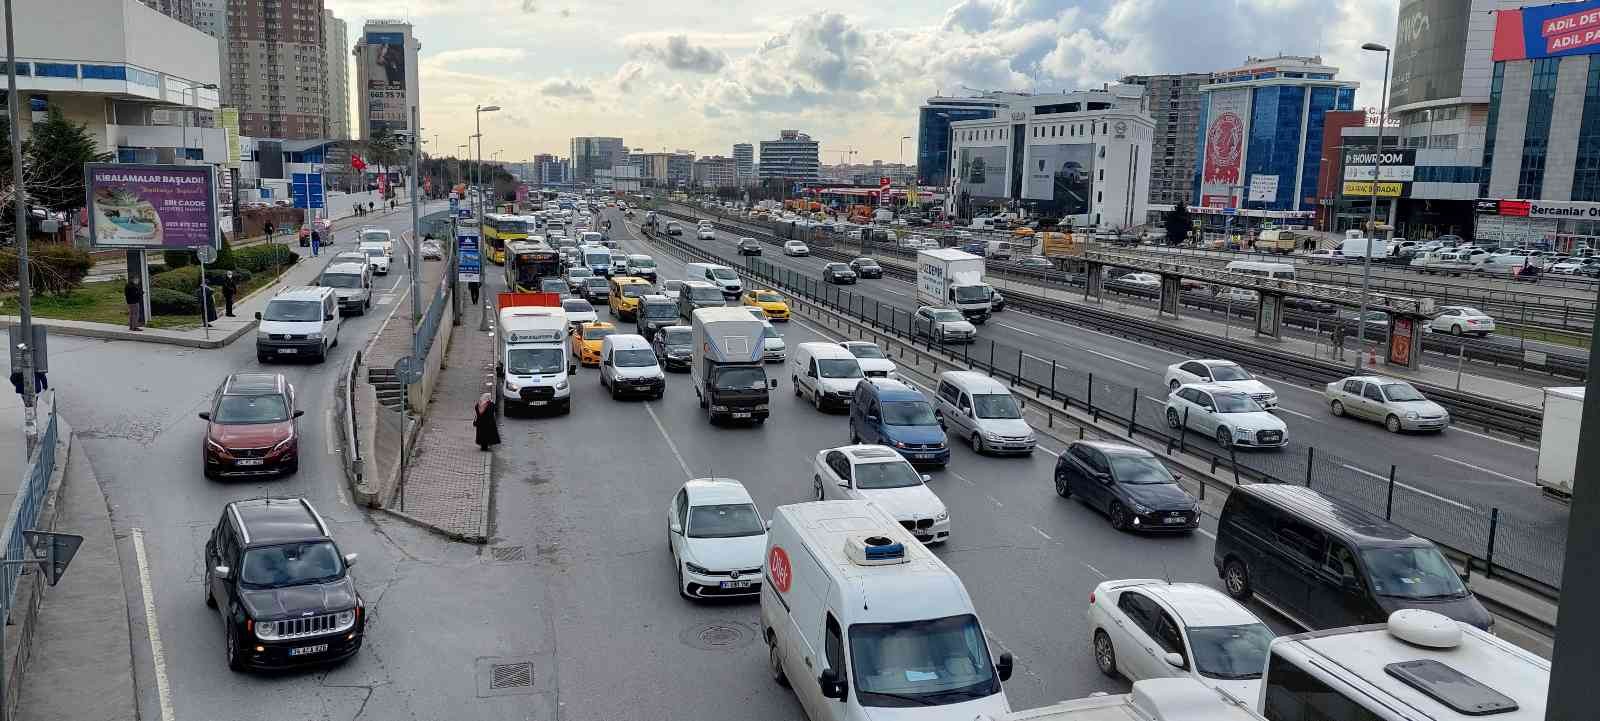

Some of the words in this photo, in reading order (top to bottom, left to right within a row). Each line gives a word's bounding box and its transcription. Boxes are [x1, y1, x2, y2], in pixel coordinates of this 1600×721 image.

[1547, 18, 1576, 33] ADİL
[1580, 11, 1600, 25] DE
[1552, 34, 1581, 49] ADİL
[95, 173, 161, 183] KİRALAMALAR
[162, 175, 204, 186] BAŞLADI!
[178, 199, 207, 207] CADDE
[1531, 205, 1585, 217] Sercanlar
